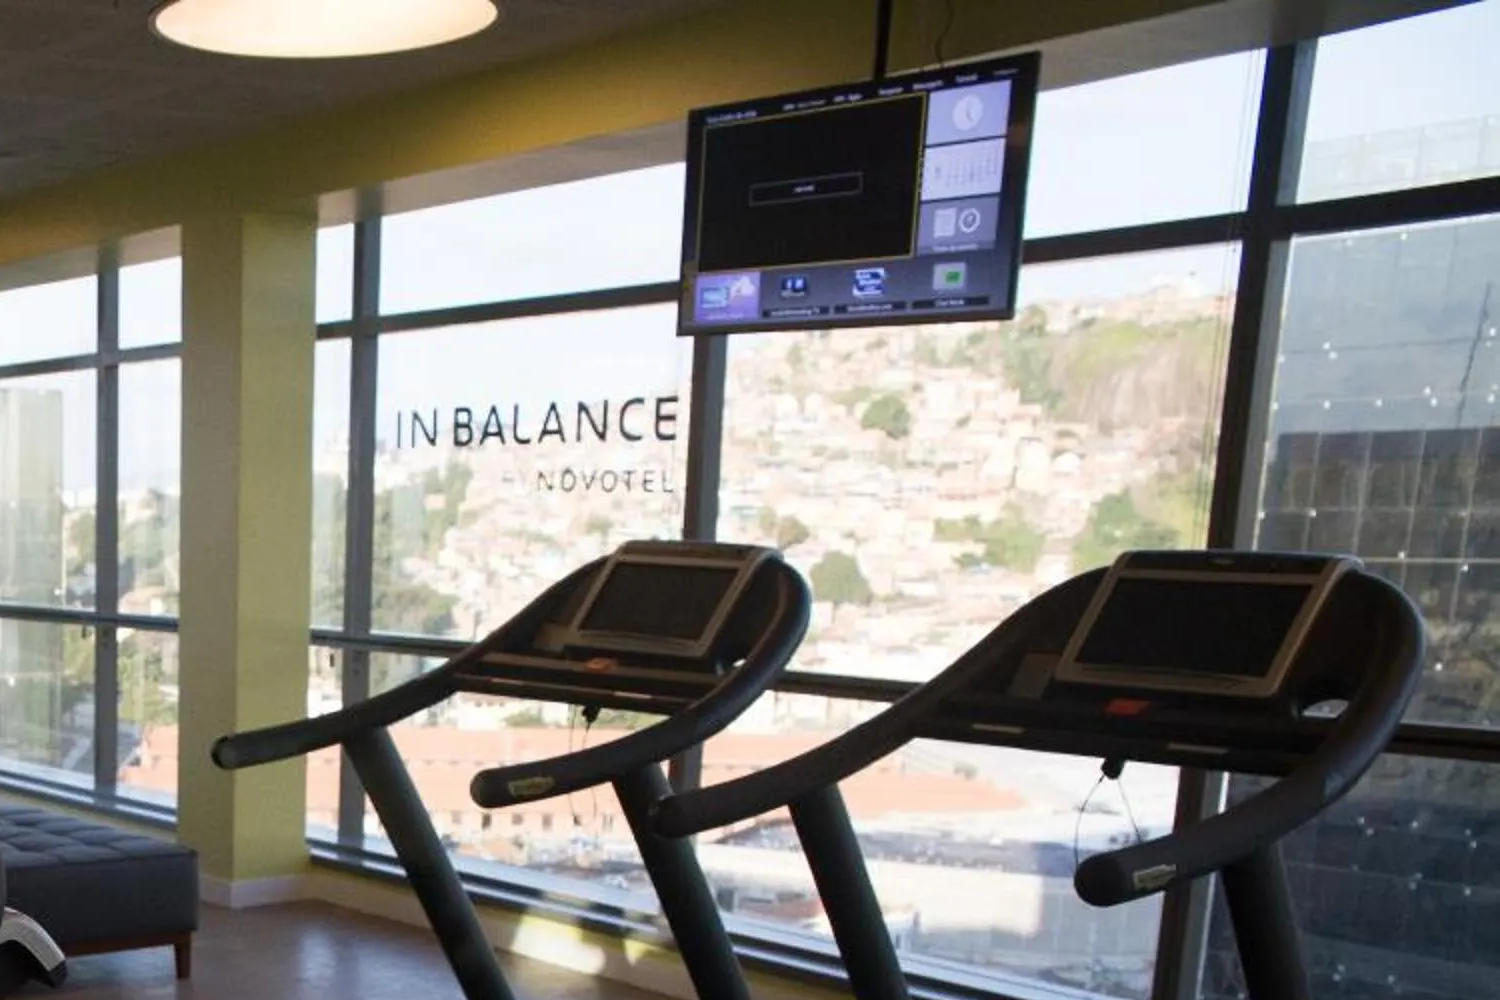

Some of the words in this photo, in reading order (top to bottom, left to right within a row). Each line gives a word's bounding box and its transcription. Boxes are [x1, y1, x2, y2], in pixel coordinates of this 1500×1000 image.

[397, 408, 437, 448] IN
[453, 396, 680, 447] BALANCE
[536, 468, 674, 494] NOVOTEL
